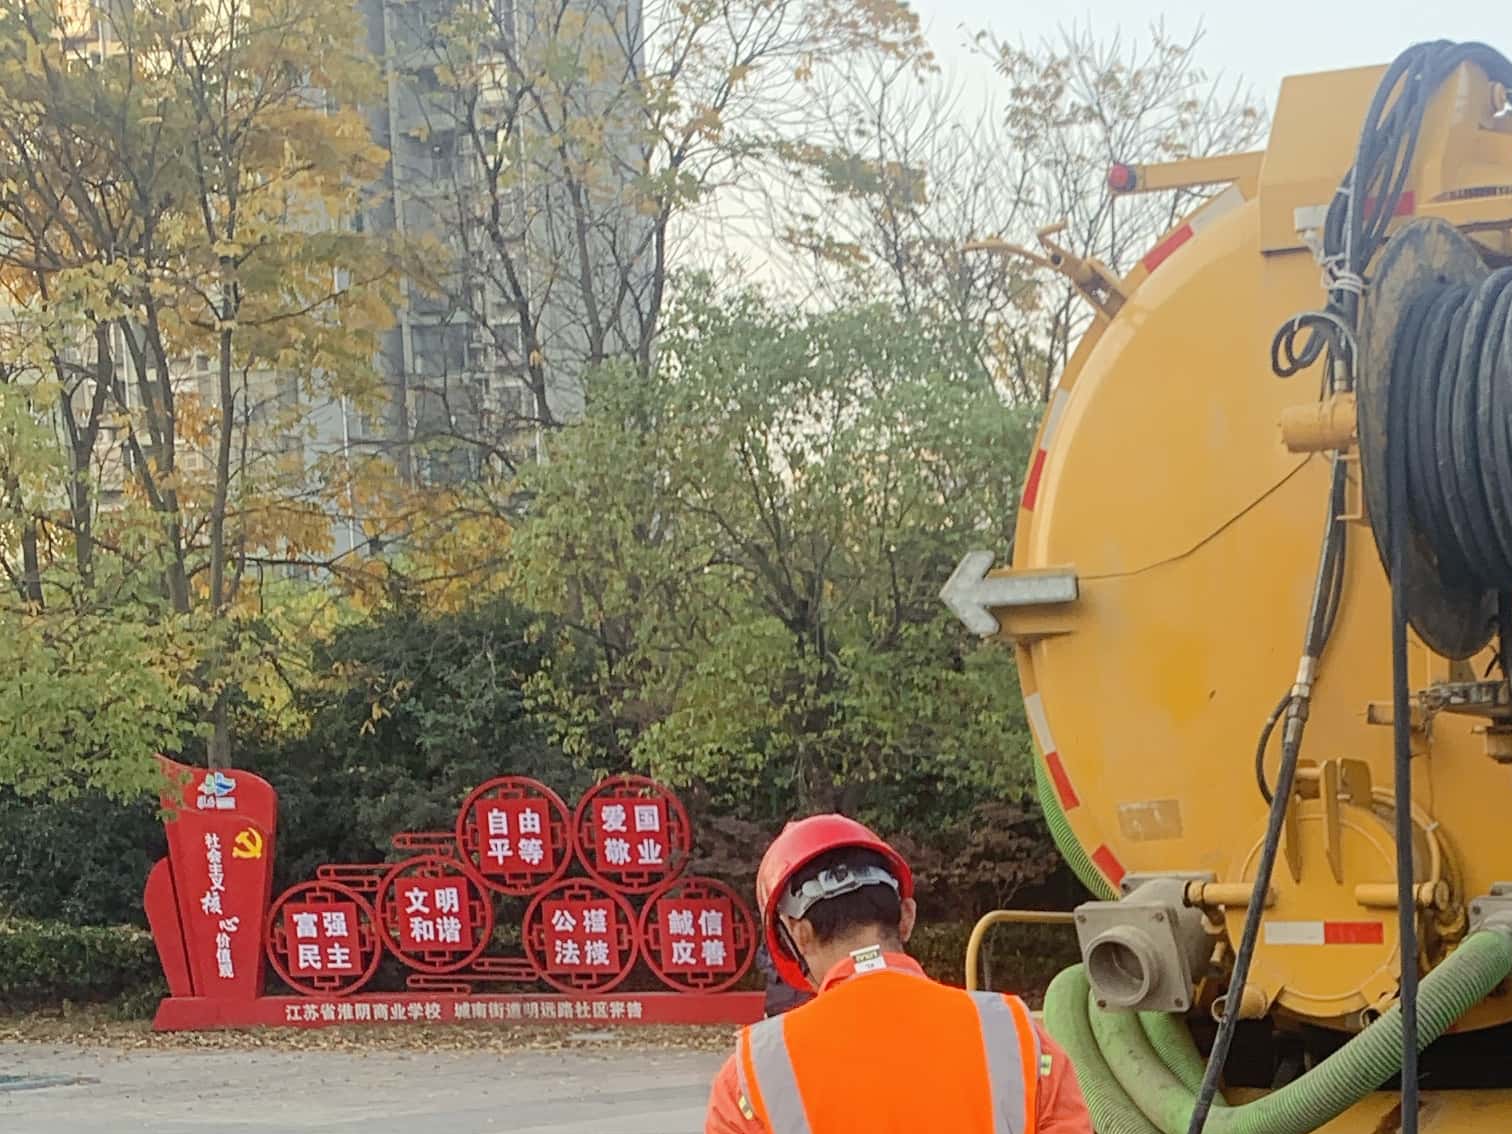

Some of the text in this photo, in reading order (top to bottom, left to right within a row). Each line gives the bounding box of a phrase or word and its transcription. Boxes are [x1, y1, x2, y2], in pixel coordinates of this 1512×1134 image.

[487, 807, 542, 836] 自由
[601, 804, 660, 832] 爱国
[487, 838, 544, 865] 平等
[604, 838, 663, 865] 敬业
[404, 886, 460, 914] 文明
[293, 911, 349, 939] 富强
[409, 915, 462, 943] 和谐
[298, 942, 352, 970] 民主
